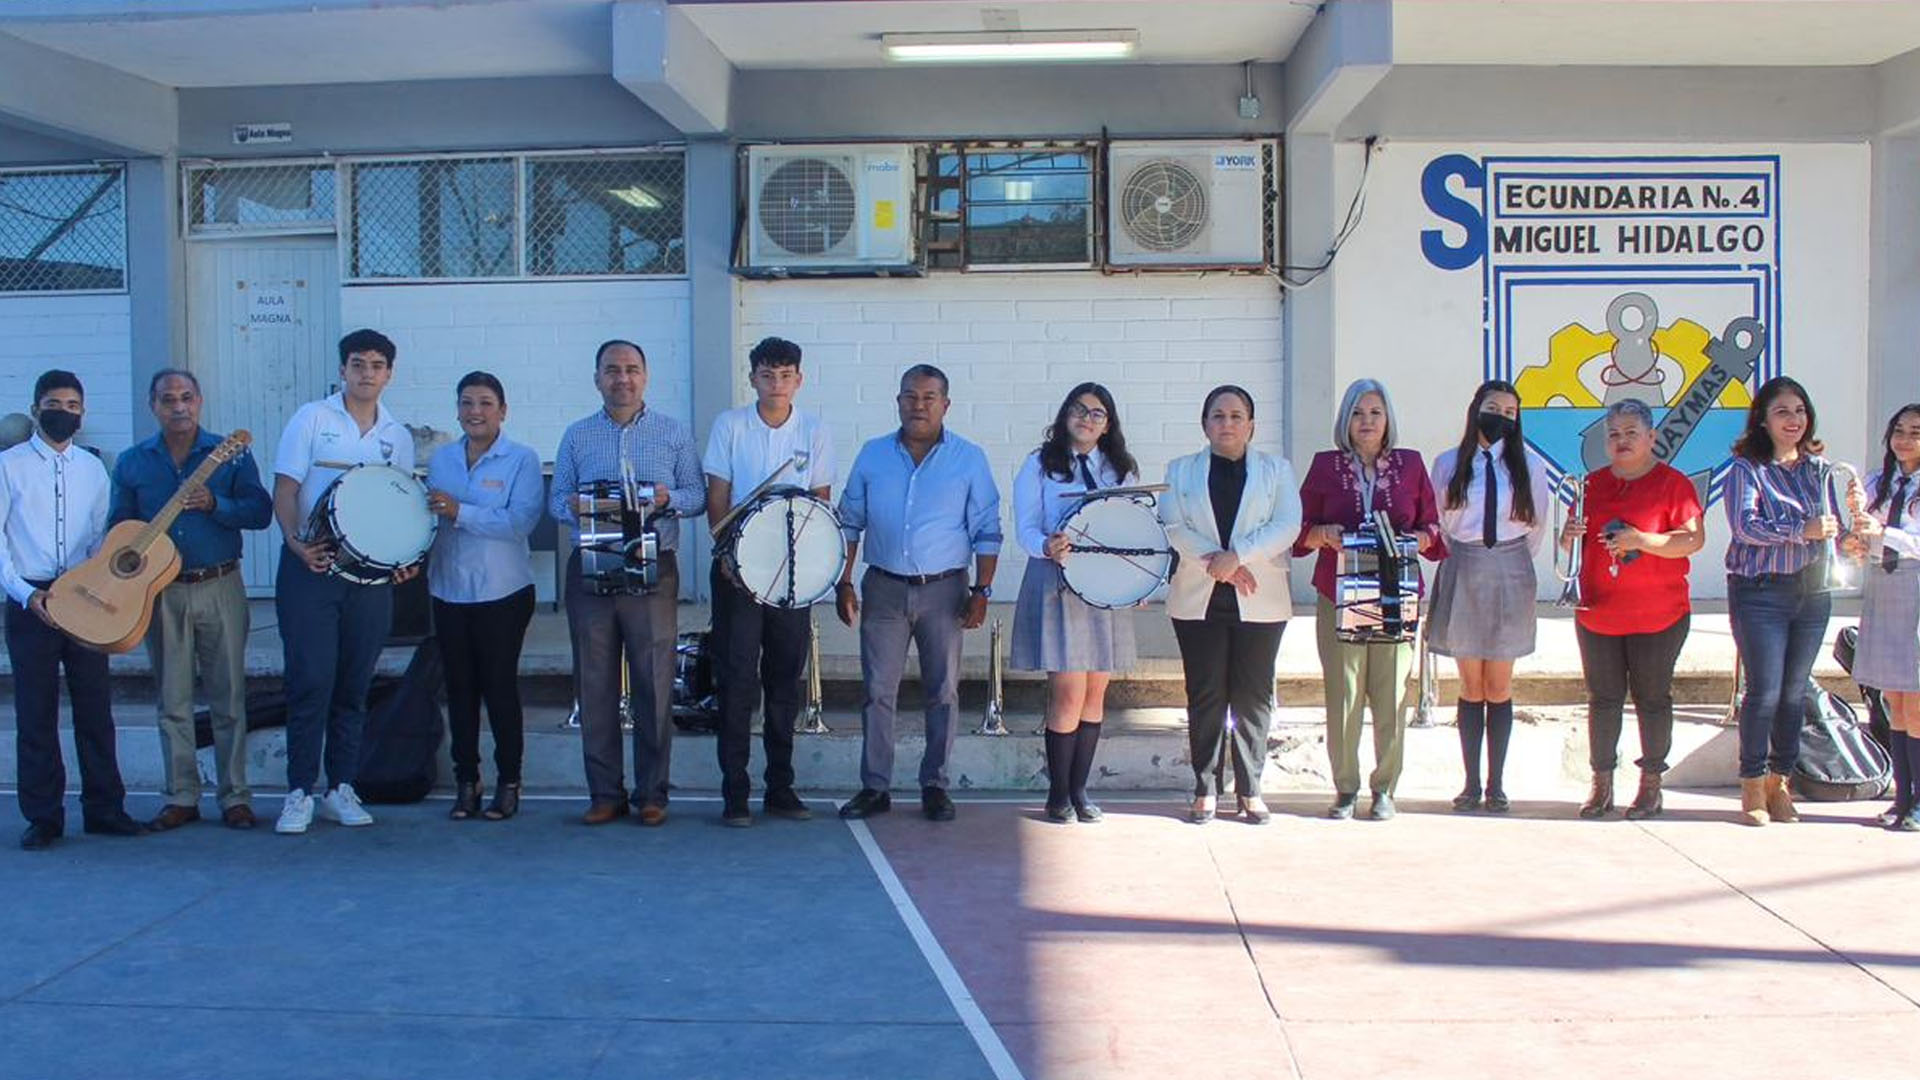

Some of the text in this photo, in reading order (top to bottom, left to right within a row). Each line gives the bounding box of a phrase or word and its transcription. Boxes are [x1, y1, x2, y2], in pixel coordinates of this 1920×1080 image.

[1225, 155, 1256, 166] YORK
[1494, 223, 1765, 254] MIGUEL HIDALGO
[257, 295, 285, 306] AULA
[250, 313, 292, 324] MAGNA
[1650, 363, 1728, 459] UAYMAS
